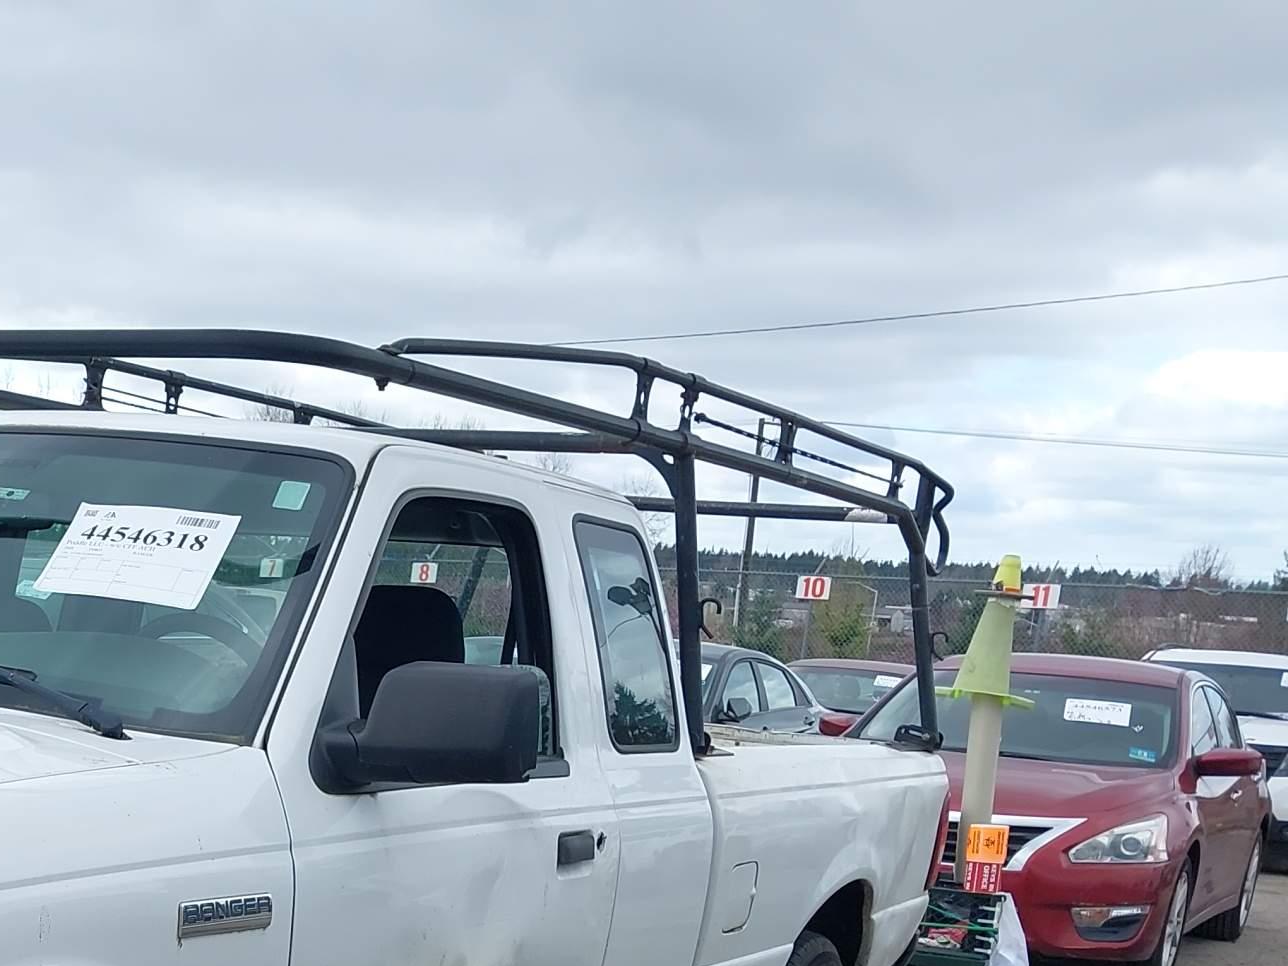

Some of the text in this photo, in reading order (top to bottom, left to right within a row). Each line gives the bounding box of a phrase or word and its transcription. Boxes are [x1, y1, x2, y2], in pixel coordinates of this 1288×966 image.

[81, 524, 209, 552] 44546318
[266, 559, 277, 577] 7
[419, 563, 430, 582] 8
[803, 576, 826, 598] 10
[1032, 585, 1051, 607] 11
[982, 865, 990, 890] OFFICE
[184, 896, 272, 924] RANGER
